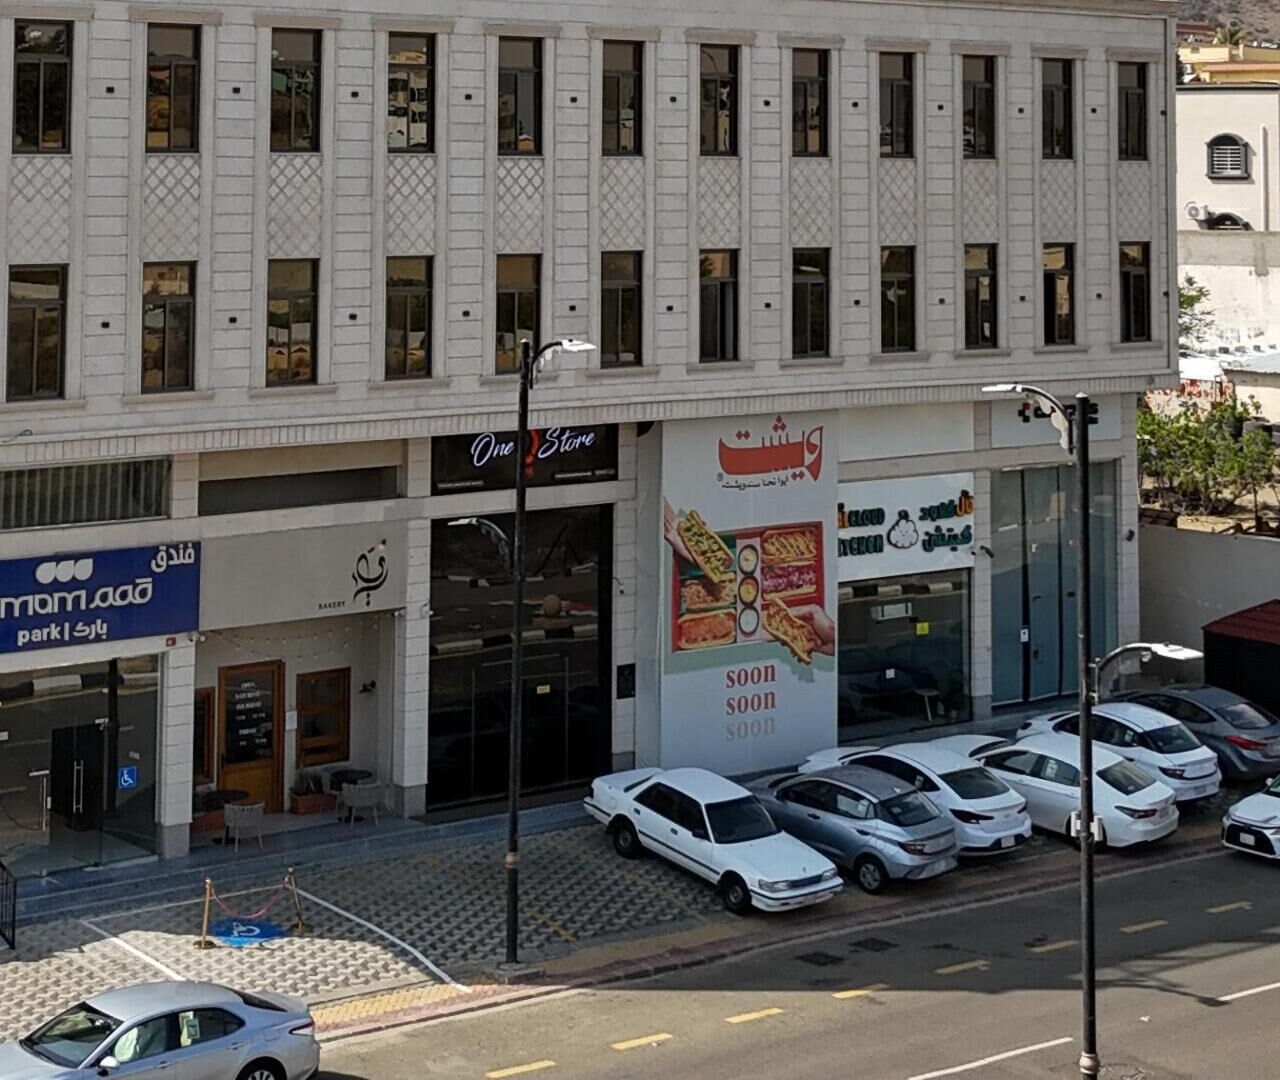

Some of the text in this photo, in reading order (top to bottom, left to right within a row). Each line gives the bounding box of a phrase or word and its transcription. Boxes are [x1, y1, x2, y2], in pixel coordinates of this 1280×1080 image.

[471, 425, 596, 467] One Store
[150, 542, 195, 573] فندق
[17, 622, 60, 646] park
[73, 618, 108, 640] بارك
[726, 664, 776, 689] soon
[726, 690, 776, 716] soon
[726, 717, 775, 741] soon
